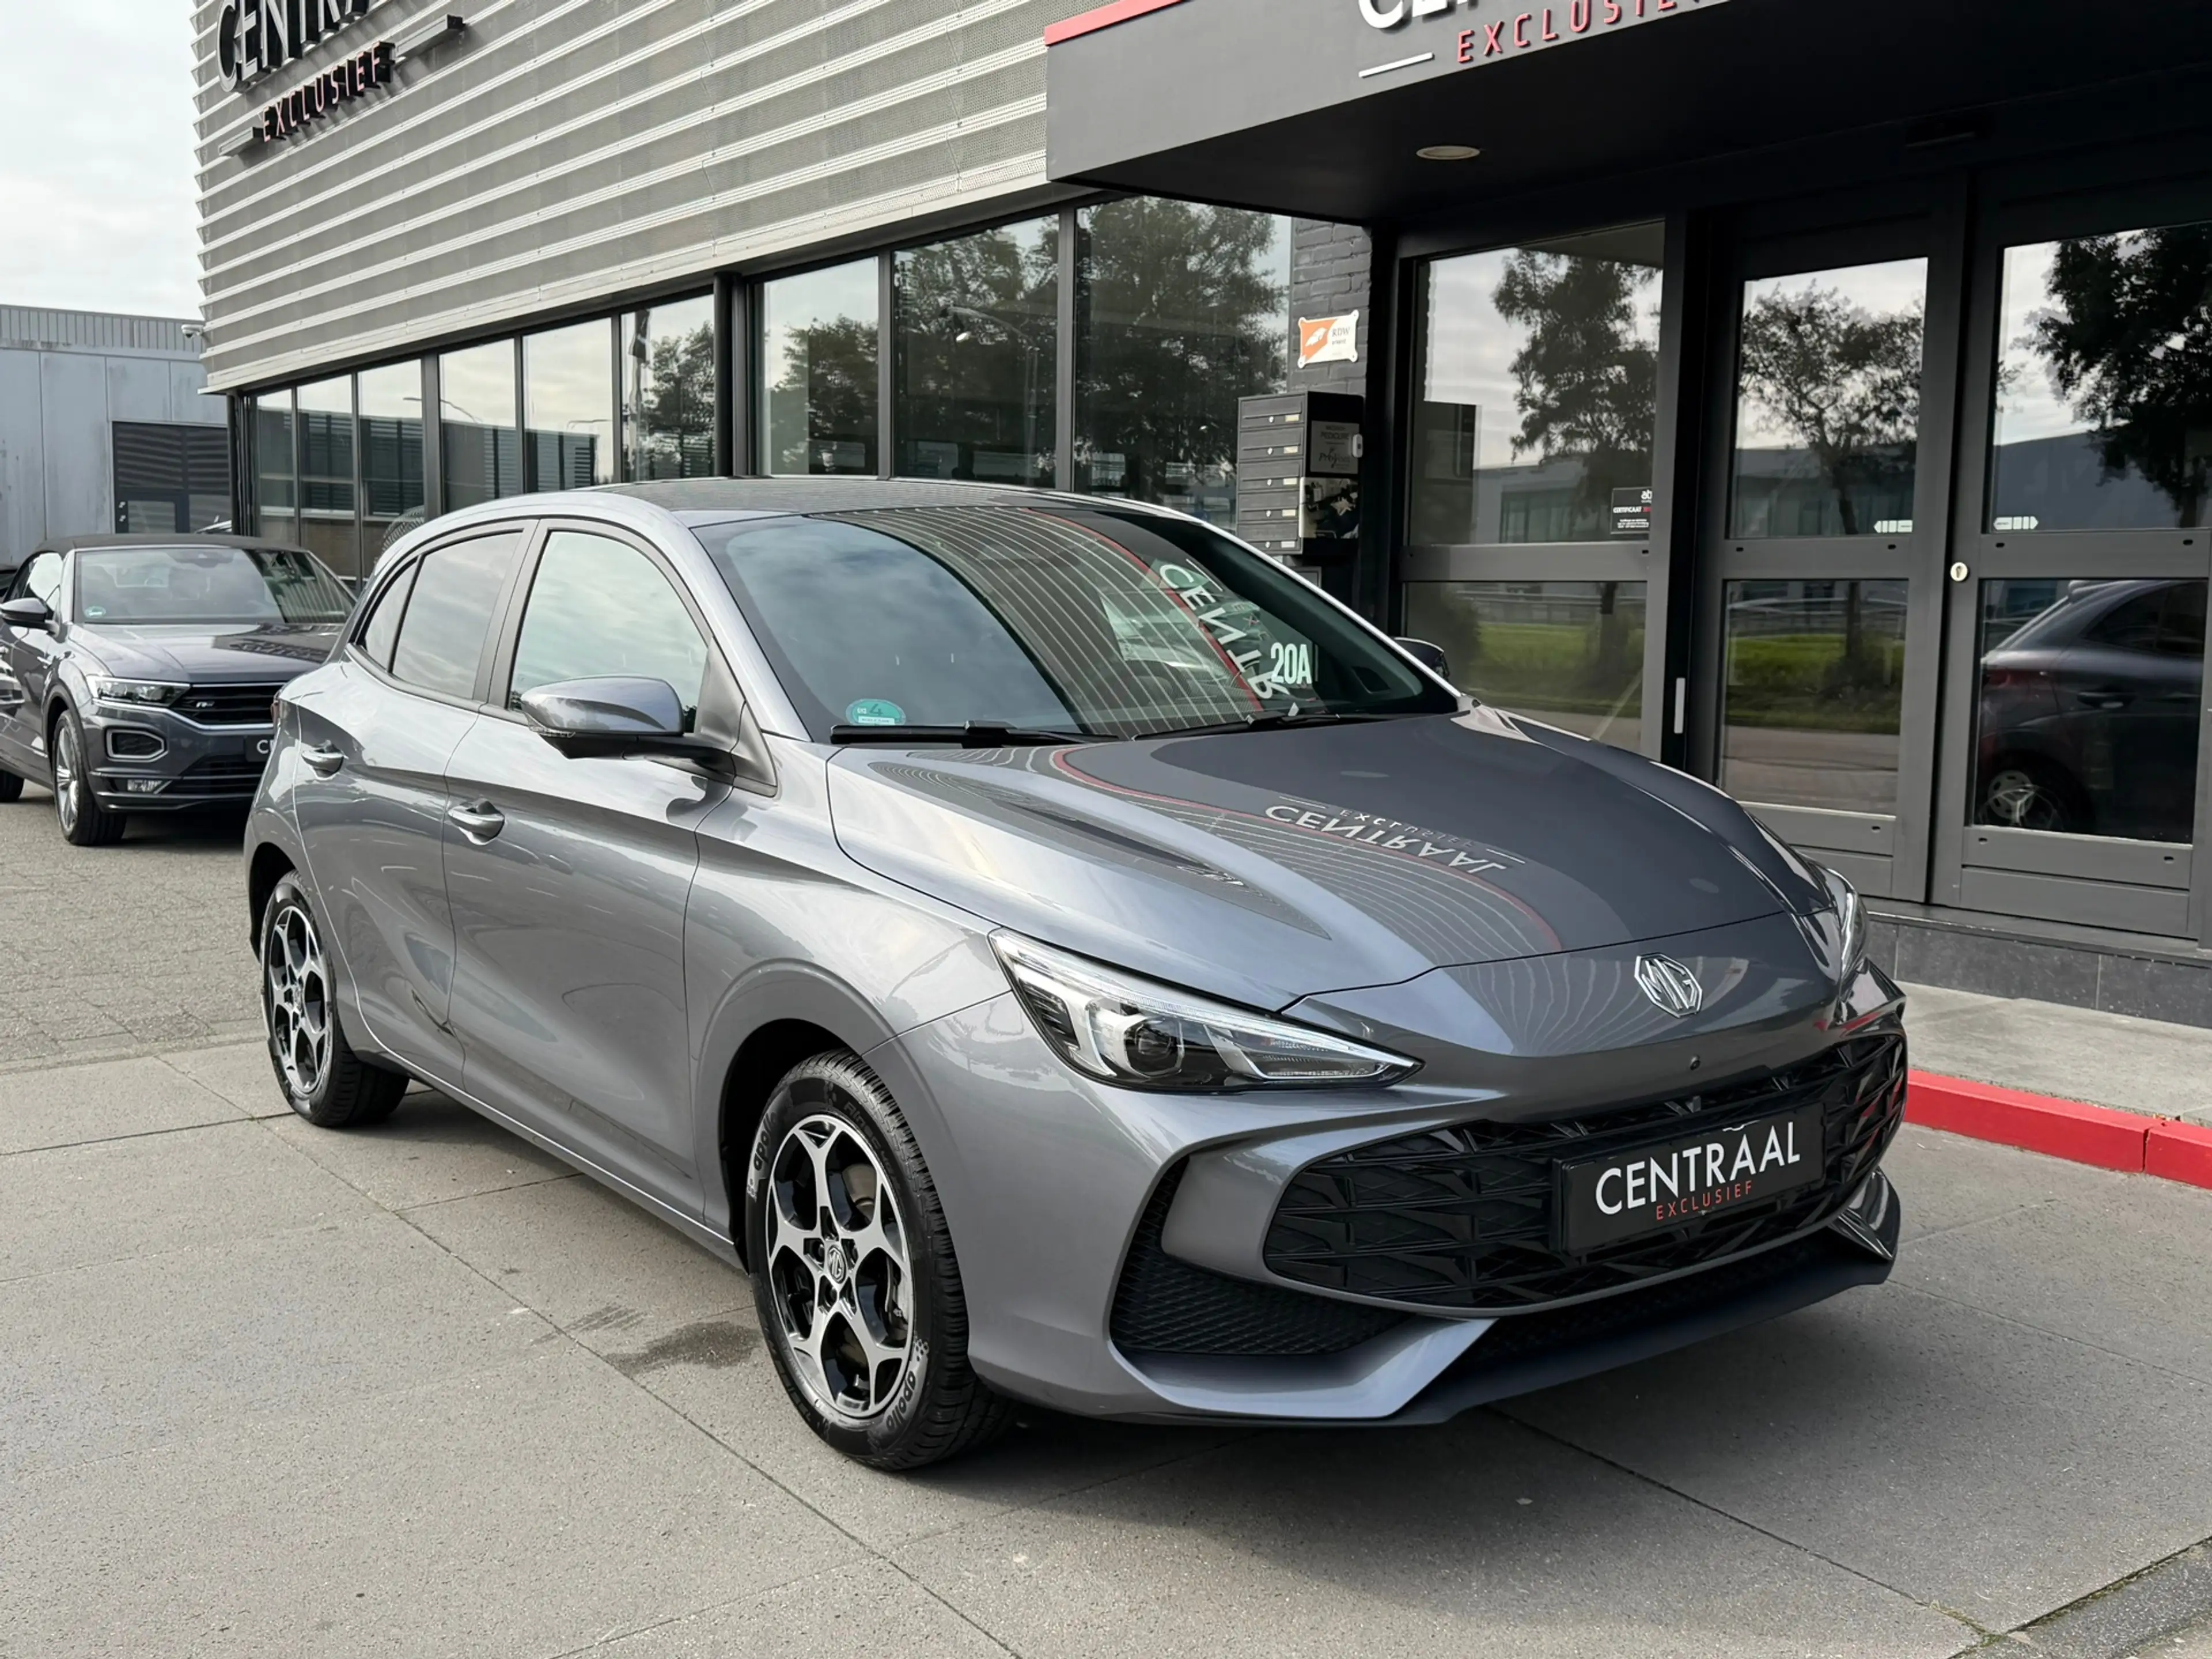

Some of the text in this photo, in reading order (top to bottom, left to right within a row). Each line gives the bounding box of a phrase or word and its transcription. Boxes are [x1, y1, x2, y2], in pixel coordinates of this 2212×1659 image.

[262, 41, 394, 143] EXCLUSIEF
[1332, 327, 1350, 337] RDW
[1271, 642, 1312, 684] 20A
[1641, 957, 1699, 1011] MG
[1595, 1121, 1801, 1215] CENTRAAL
[1656, 1180, 1753, 1221] EXCLUSIEF
[828, 1250, 843, 1279] MG
[885, 1370, 916, 1431] apollo
